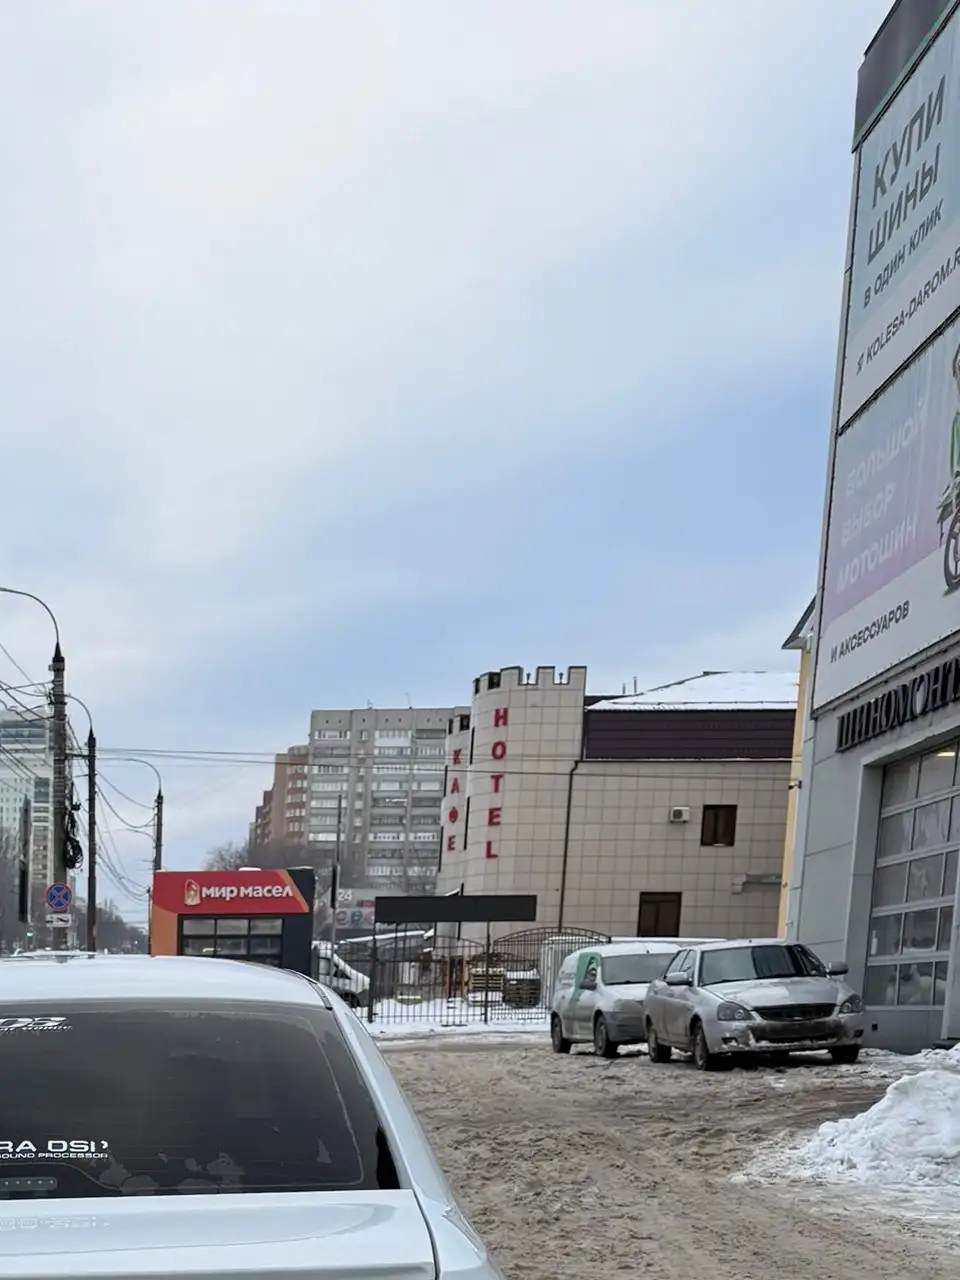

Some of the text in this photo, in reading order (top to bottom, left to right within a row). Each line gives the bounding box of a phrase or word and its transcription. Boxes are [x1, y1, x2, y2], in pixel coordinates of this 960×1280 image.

[872, 72, 946, 209] КУПИ
[863, 198, 944, 309] В ОДИН КЛИК
[867, 142, 941, 265] ШИНЫ
[837, 511, 918, 593] МОТОШИН
[842, 481, 896, 546] ВЫБОР
[830, 600, 910, 664] И АКСЕССУАРОВ
[447, 748, 461, 851] КАФЕ
[485, 707, 508, 858] HOTEL
[201, 885, 294, 901] мир масел
